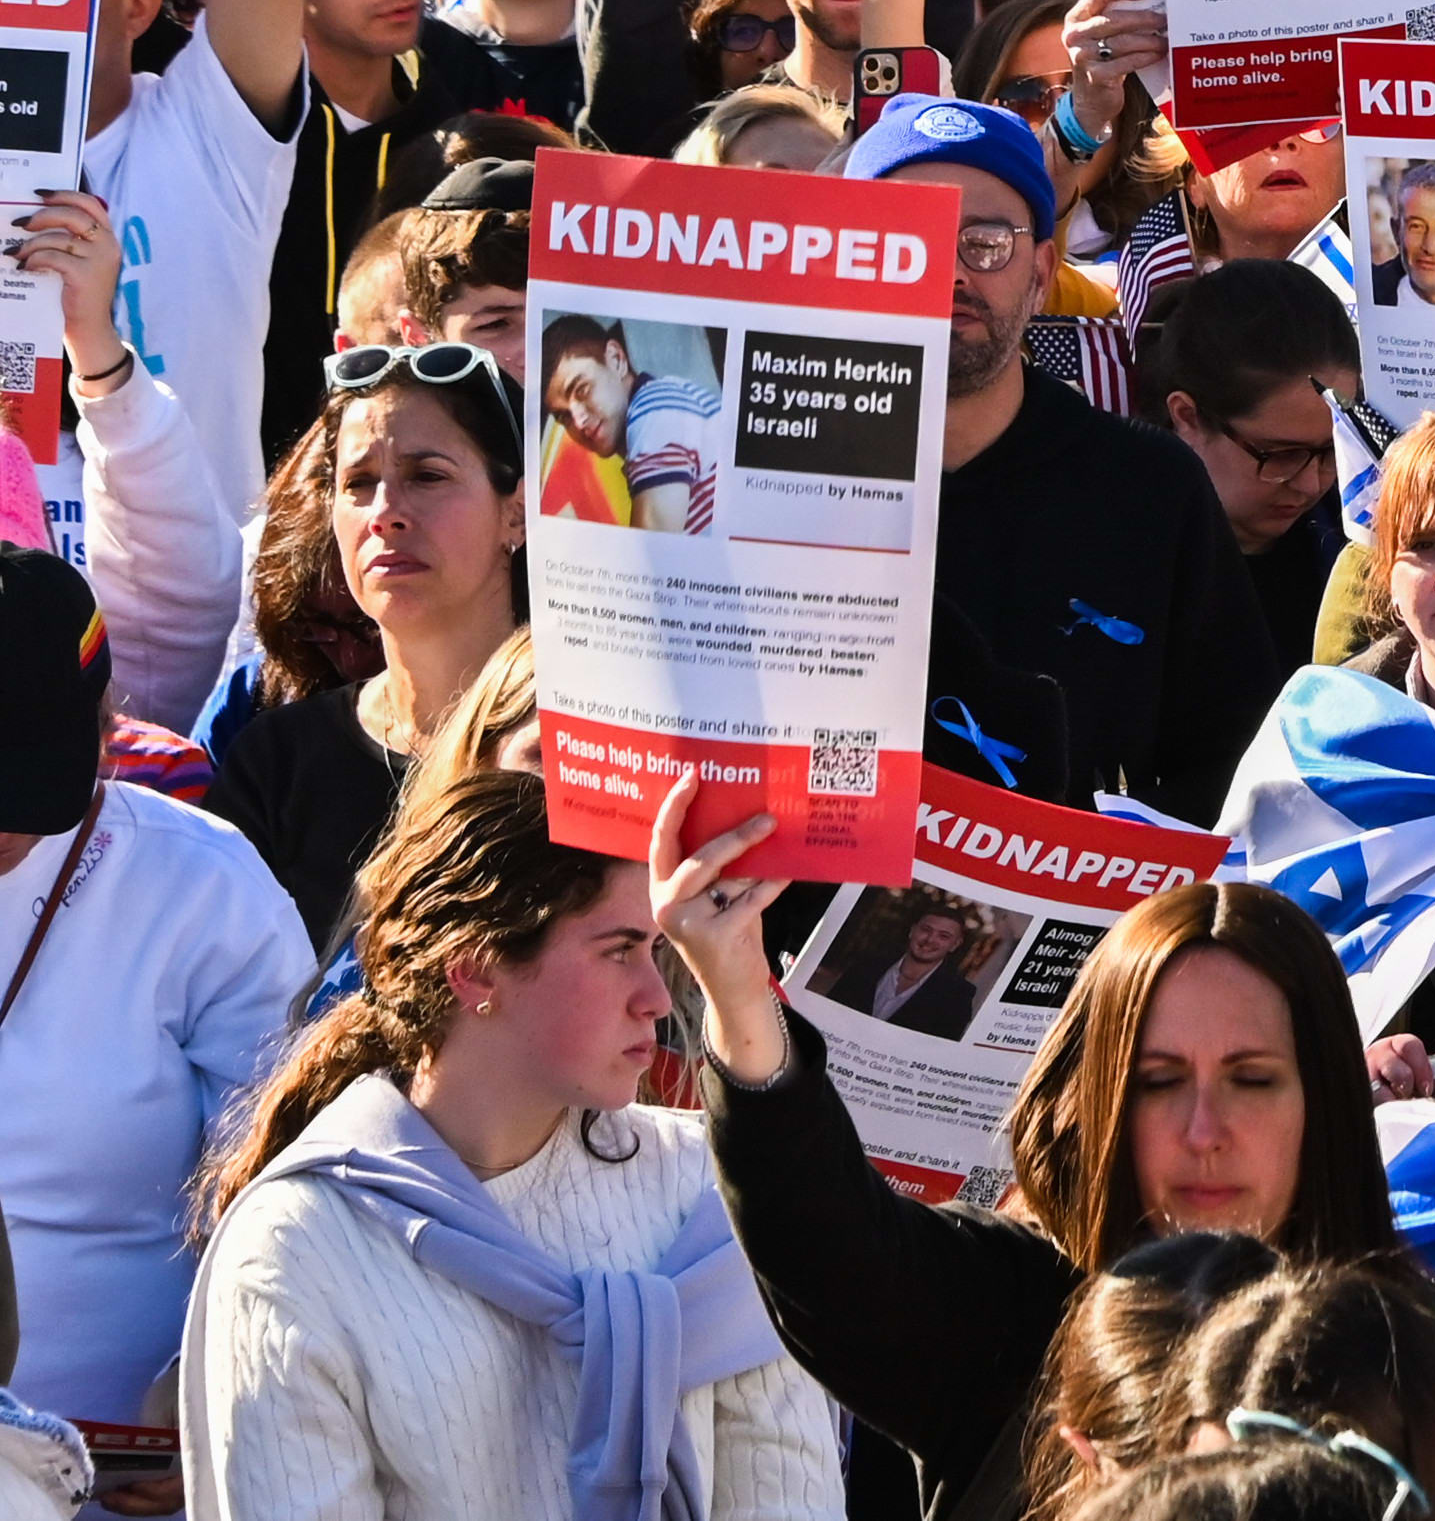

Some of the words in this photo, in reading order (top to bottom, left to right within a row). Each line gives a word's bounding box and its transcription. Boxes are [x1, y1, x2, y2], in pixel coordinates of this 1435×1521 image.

[1190, 33, 1215, 42] Take
[1228, 29, 1258, 41] photo
[1274, 25, 1294, 35] this
[1296, 24, 1330, 36] poster
[1356, 17, 1383, 28] share
[1191, 55, 1245, 70] Please
[1250, 51, 1285, 66] help
[1290, 48, 1333, 63] bring
[1192, 75, 1238, 89] home
[1242, 71, 1285, 85] alive.
[547, 200, 929, 287] KIDNAPPED
[751, 349, 823, 381] Maxim
[830, 357, 914, 387] Herkin
[749, 383, 781, 409] 35
[787, 387, 845, 414] years
[851, 388, 892, 415] old
[746, 412, 818, 441] Israeli
[556, 731, 606, 761] Please
[700, 761, 761, 784] them
